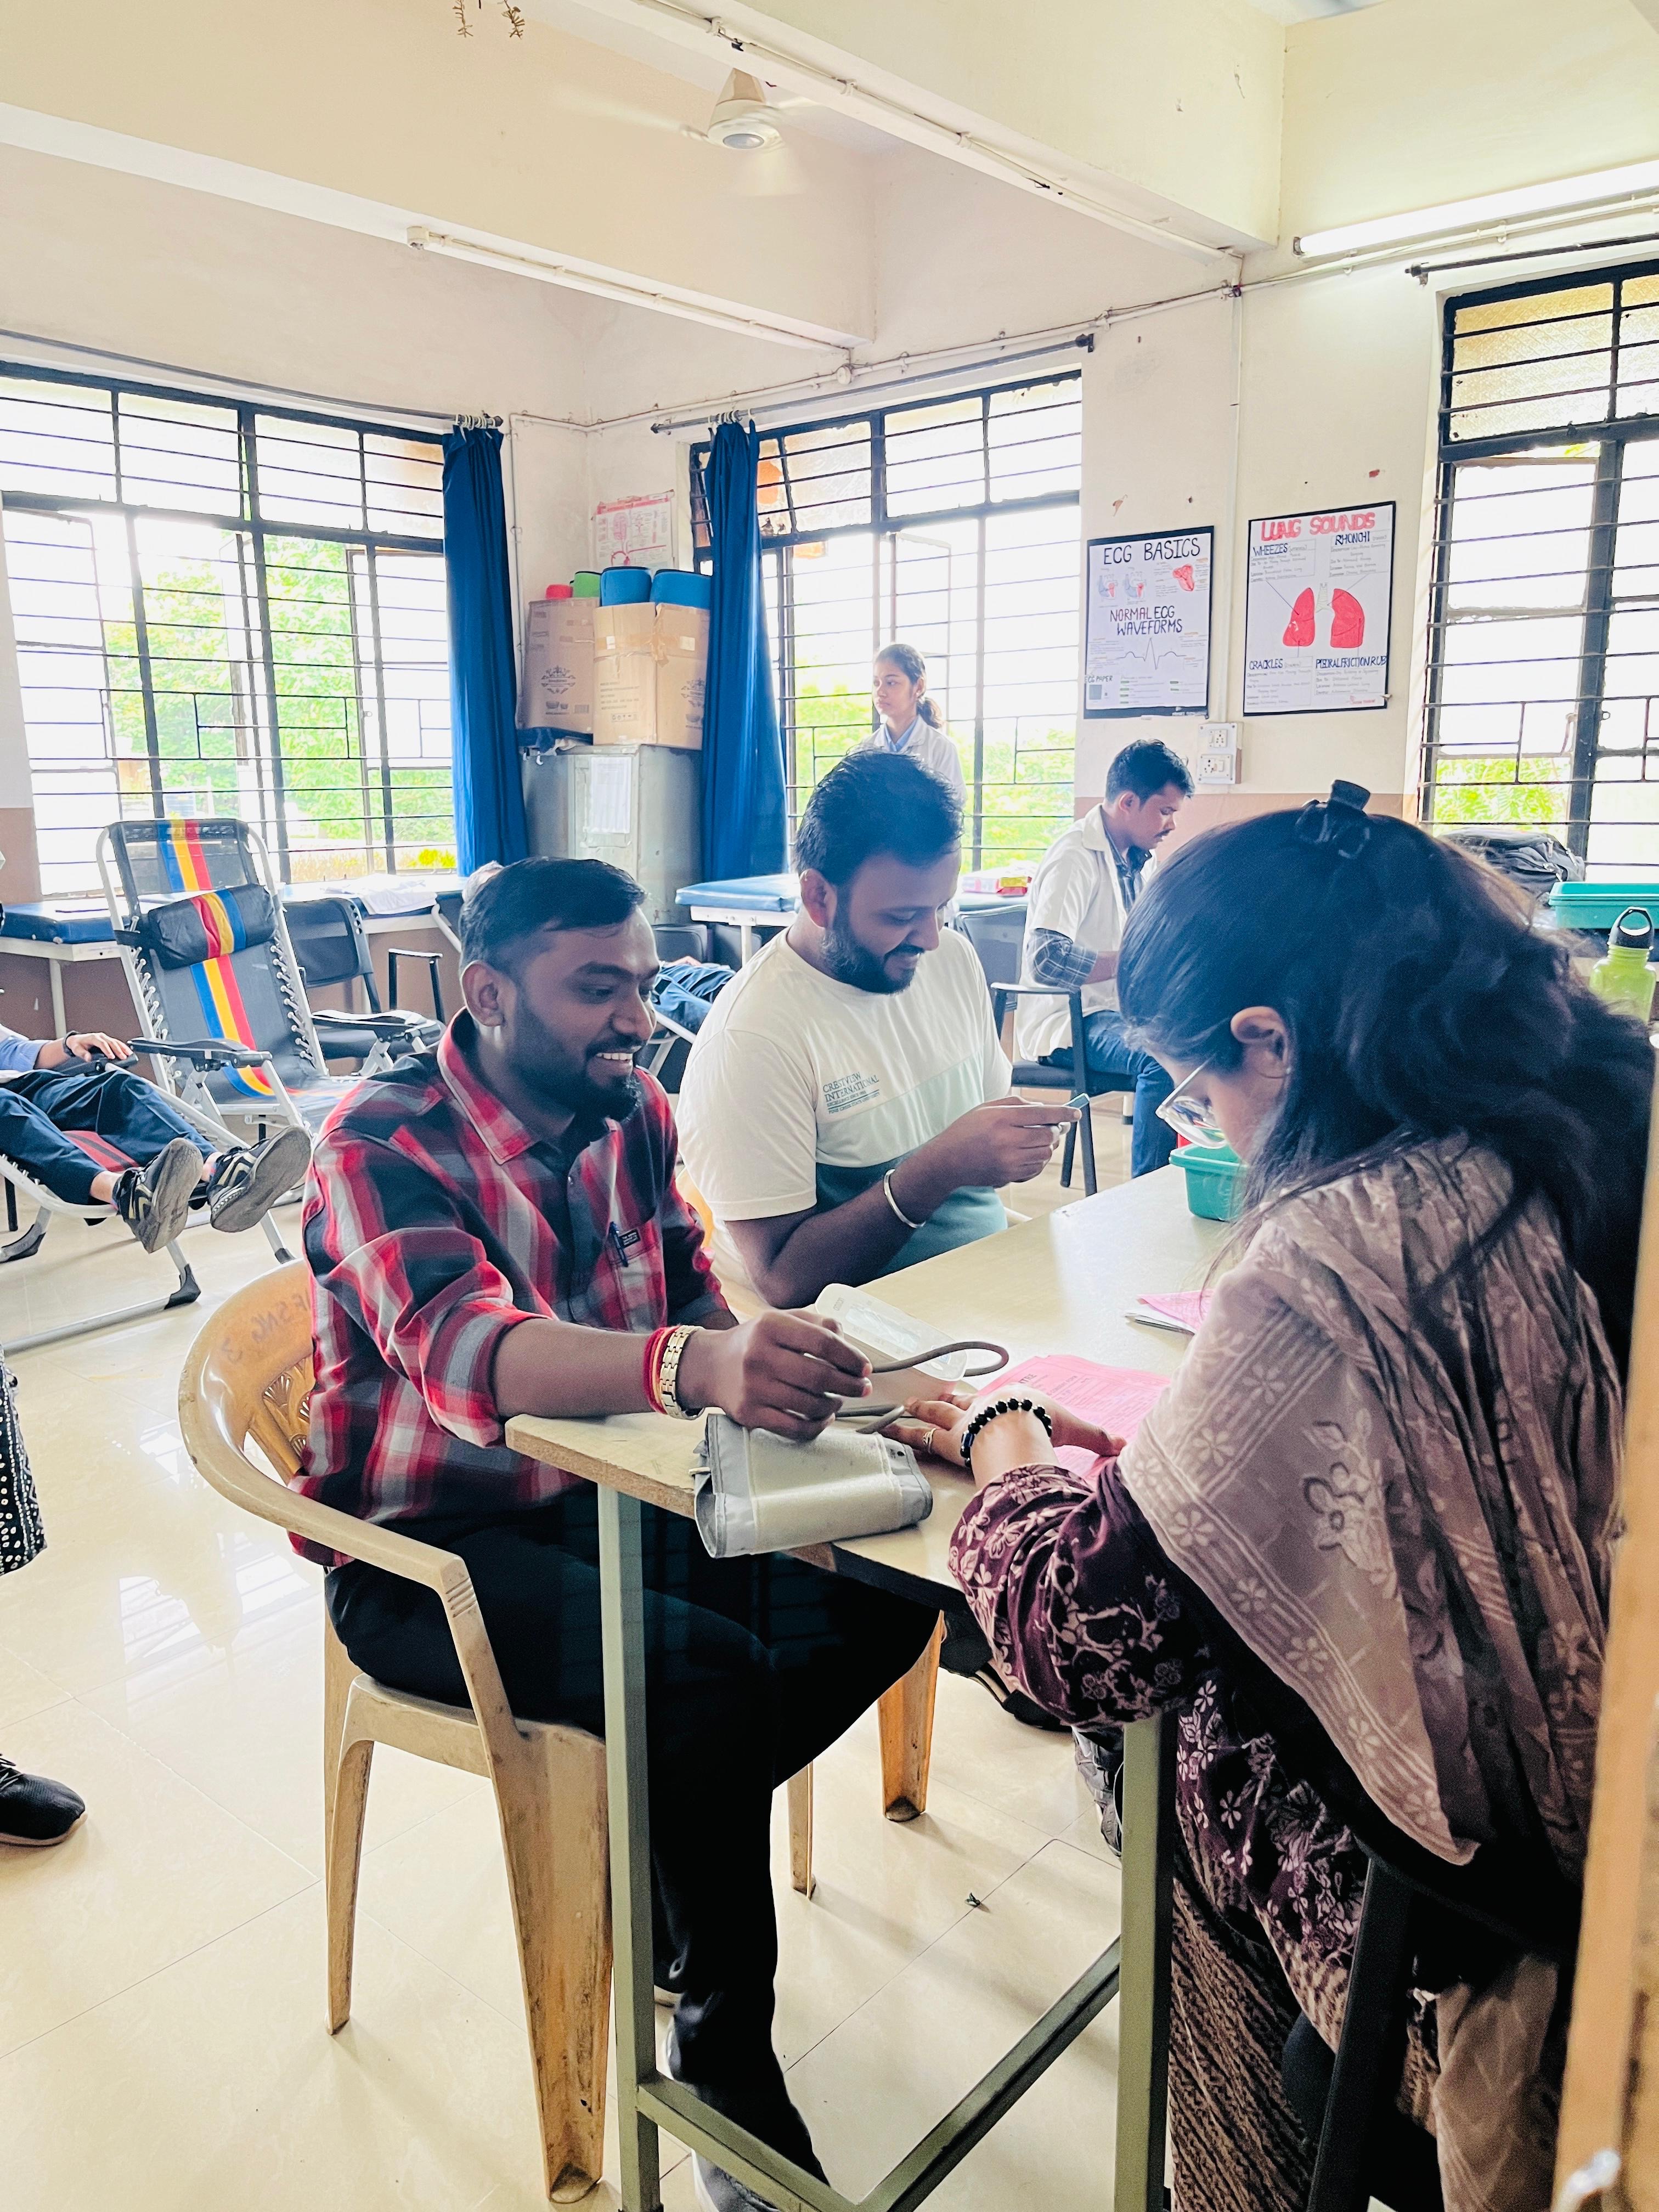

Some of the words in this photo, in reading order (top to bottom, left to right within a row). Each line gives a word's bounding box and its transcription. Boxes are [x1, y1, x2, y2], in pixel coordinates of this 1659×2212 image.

[1261, 518, 1301, 541] LUNG
[1309, 512, 1376, 535] SOUNDS
[1335, 531, 1370, 545] RHONCHI
[1104, 545, 1132, 565] ECG
[1144, 538, 1200, 561] BASICS
[1252, 543, 1288, 556] WHEEZES
[1110, 606, 1152, 622] NORMAL
[1154, 605, 1175, 619] ECG
[1117, 618, 1182, 635] WAVEFORMS
[1249, 658, 1283, 670] CRACKLES
[823, 1071, 861, 1092] CRESTVIEW
[825, 1075, 879, 1102] INTERNATIONAL
